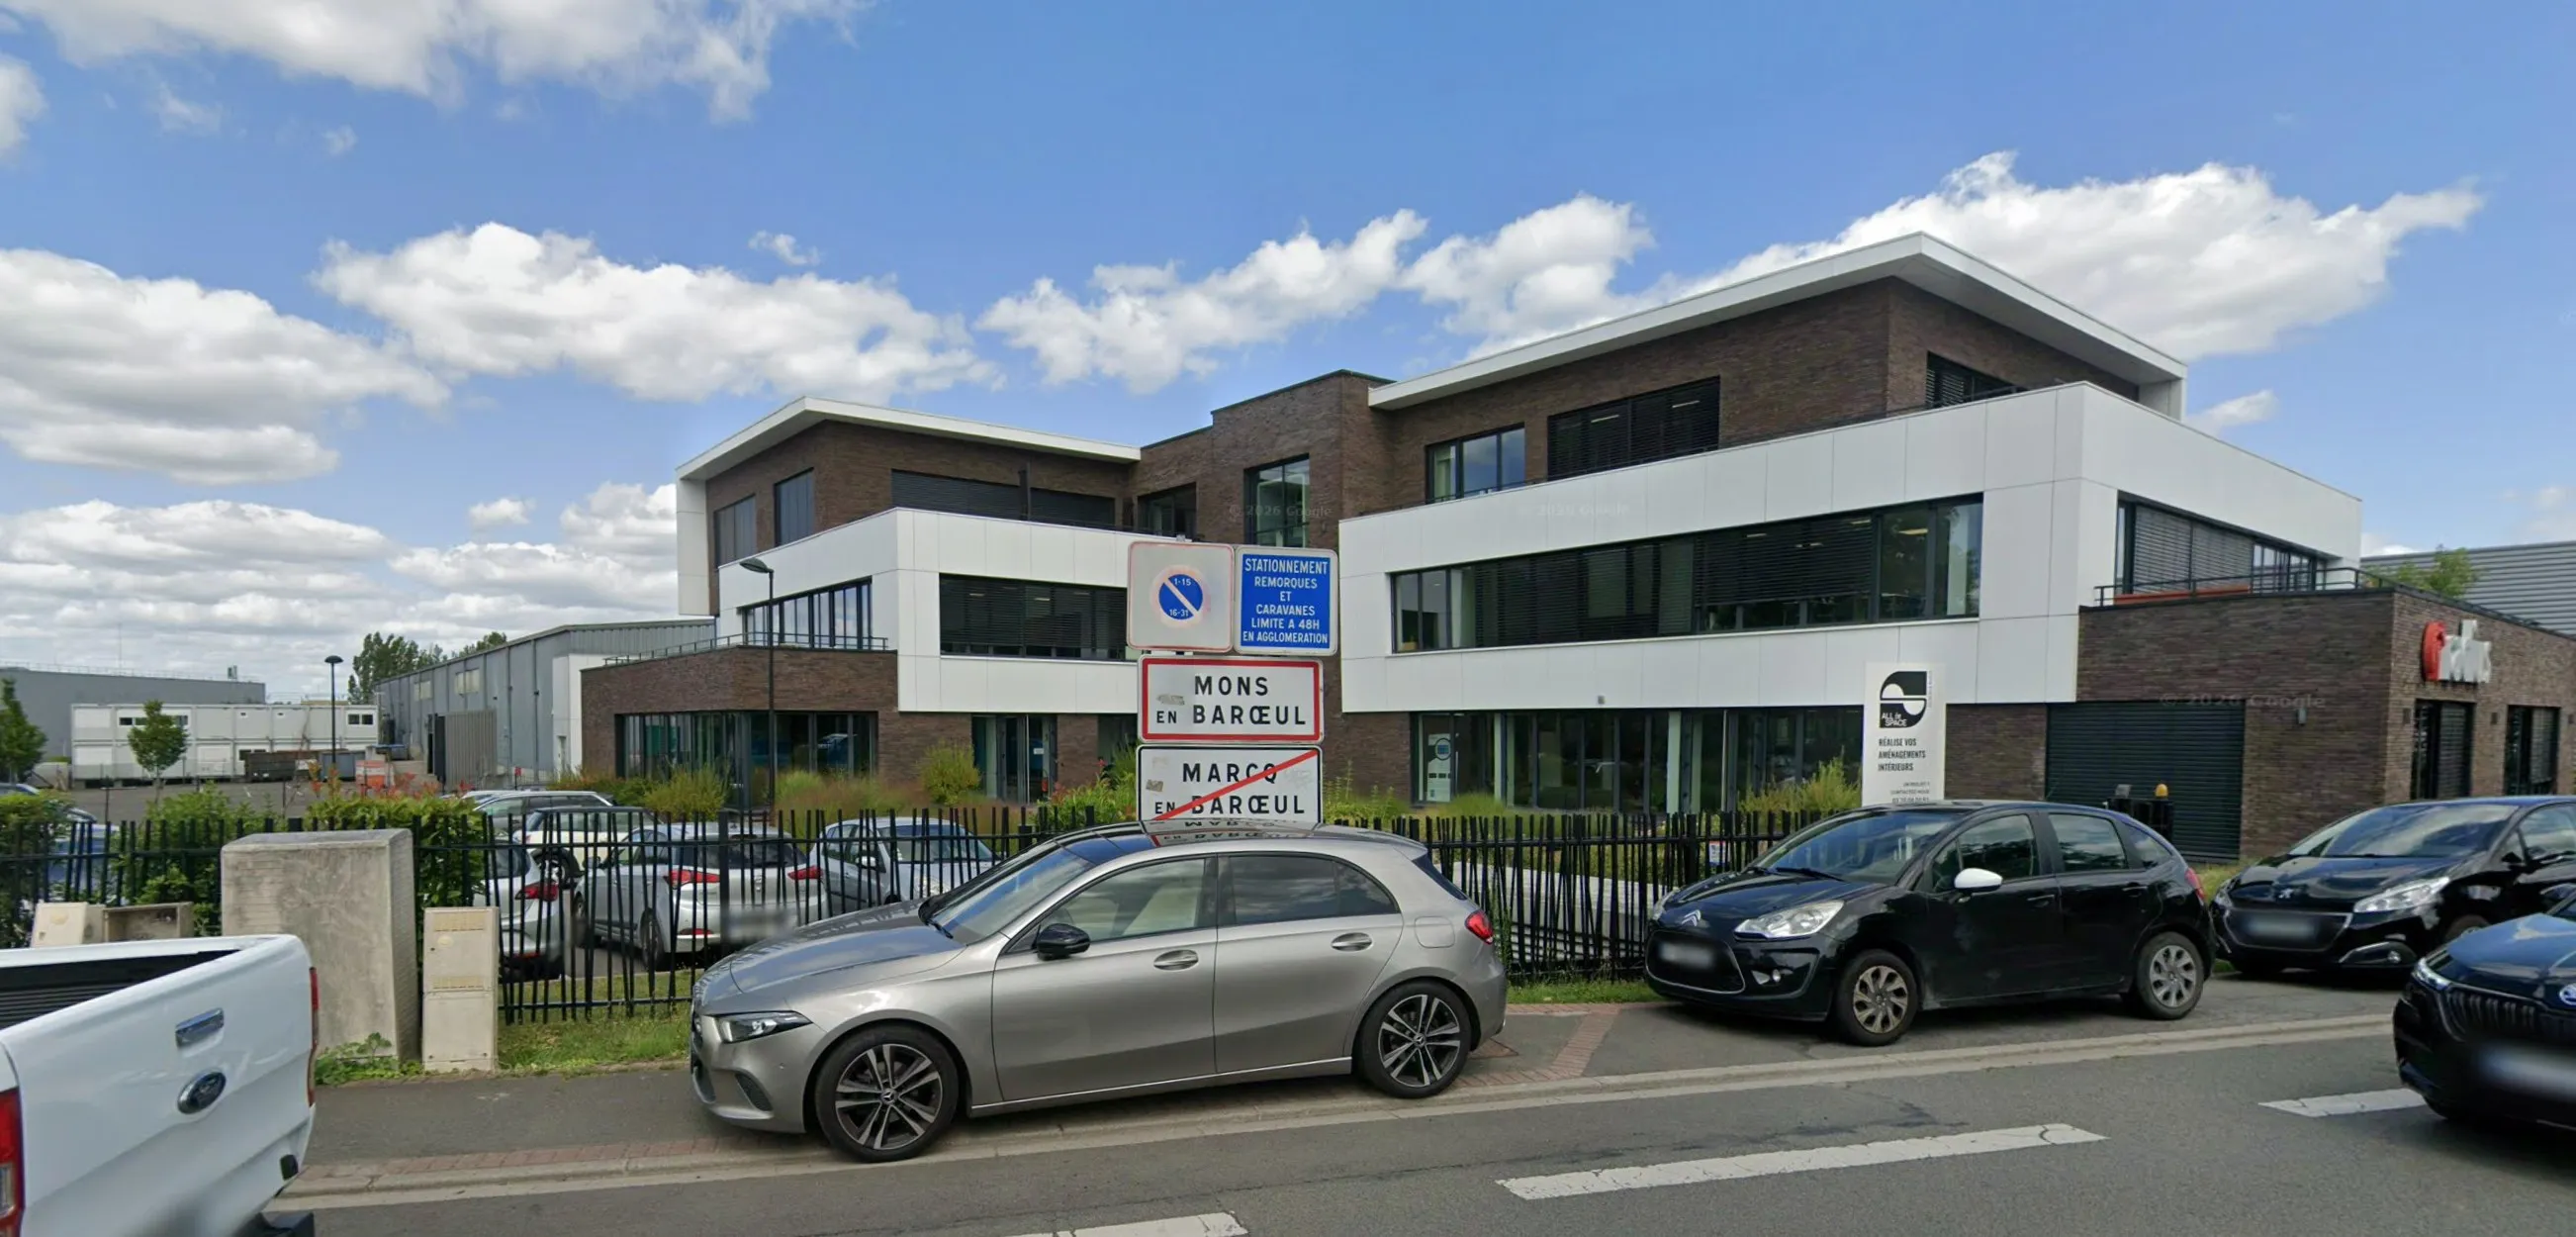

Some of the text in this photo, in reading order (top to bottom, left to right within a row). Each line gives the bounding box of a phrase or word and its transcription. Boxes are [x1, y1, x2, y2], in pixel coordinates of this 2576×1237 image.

[1244, 557, 1328, 575] STATIONNEMENT
[1254, 576, 1318, 589] REMORQUES
[1280, 591, 1292, 602] ET
[1256, 604, 1316, 616] CARAVANES
[1251, 618, 1320, 630] LIMITE A 48H
[1242, 631, 1328, 644] EN AGGLOMERATION
[1194, 676, 1268, 696] MONS
[1156, 705, 1306, 725] EN BARŒUL
[1879, 736, 1903, 746] RÉALISE
[1878, 748, 1926, 759] AMÉNAGEMENTS
[1878, 761, 1914, 771] INTÉRIEURS
[1182, 763, 1277, 785] MARCQ
[1154, 795, 1305, 814] EN BARŒUL
